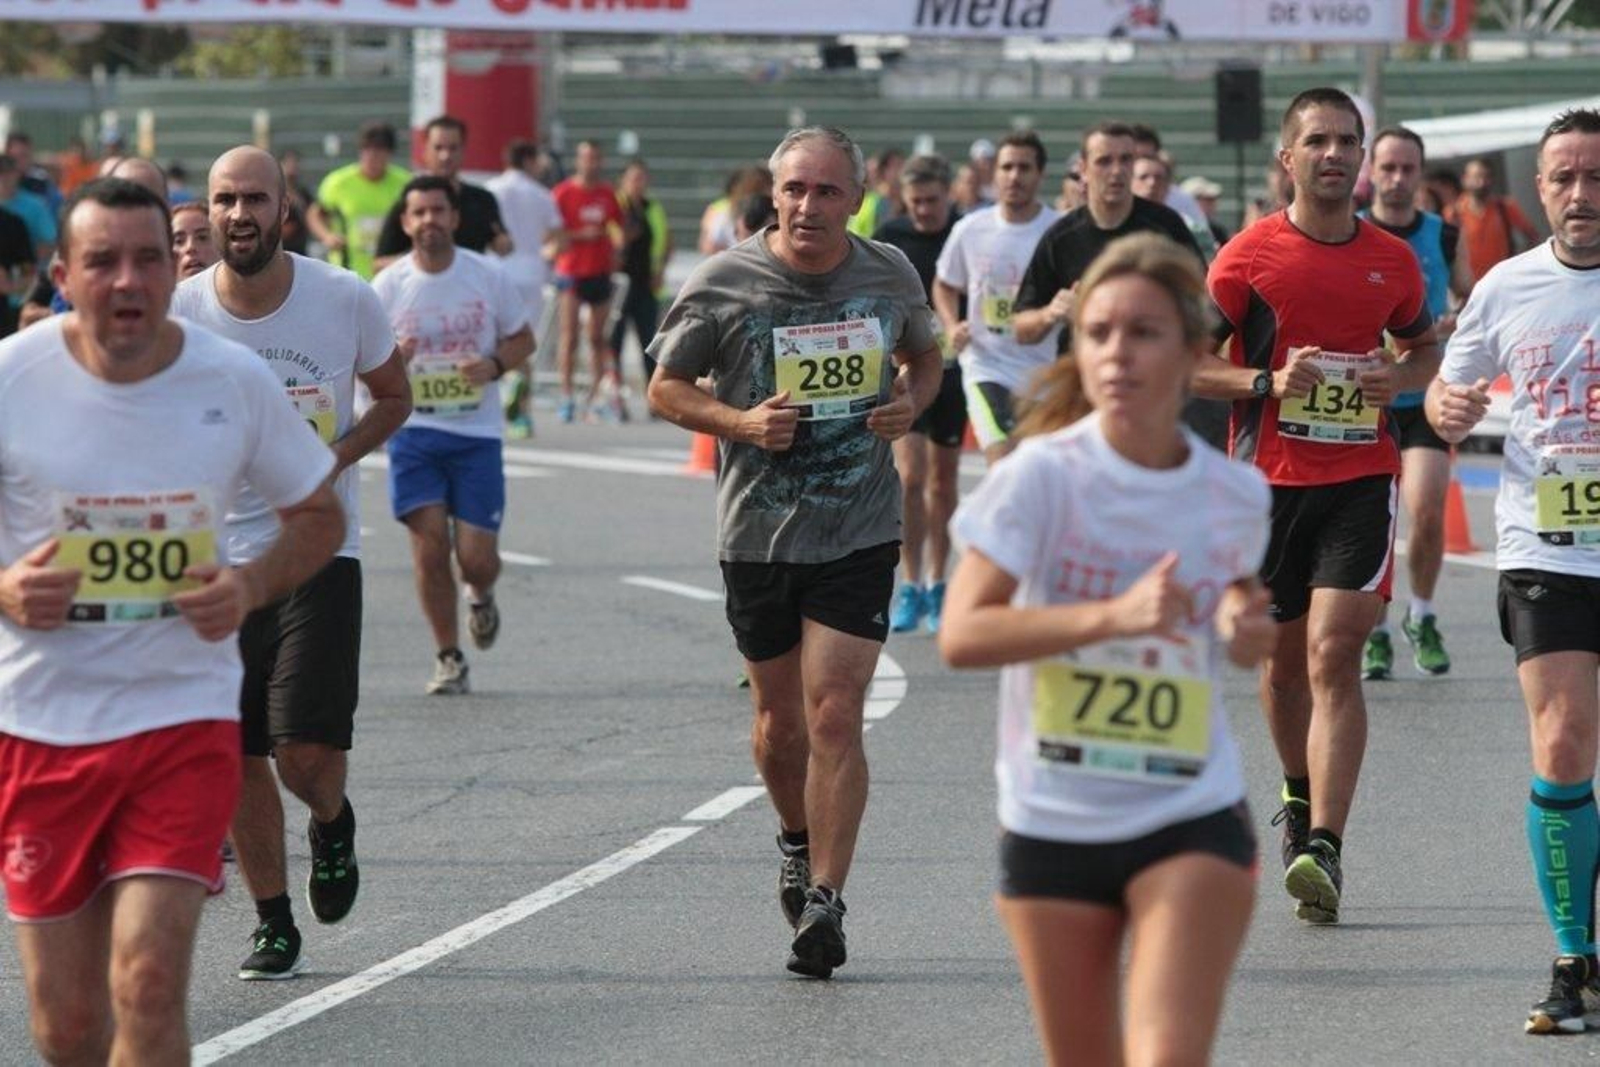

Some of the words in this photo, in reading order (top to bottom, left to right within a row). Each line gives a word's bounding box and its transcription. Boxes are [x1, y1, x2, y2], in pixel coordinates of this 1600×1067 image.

[1267, 4, 1301, 25] DE
[1309, 4, 1372, 26] VIGO
[799, 354, 864, 391] 288
[1302, 384, 1365, 416] 134
[1560, 481, 1600, 516] 19
[88, 538, 189, 583] 980
[1072, 671, 1183, 731] 720
